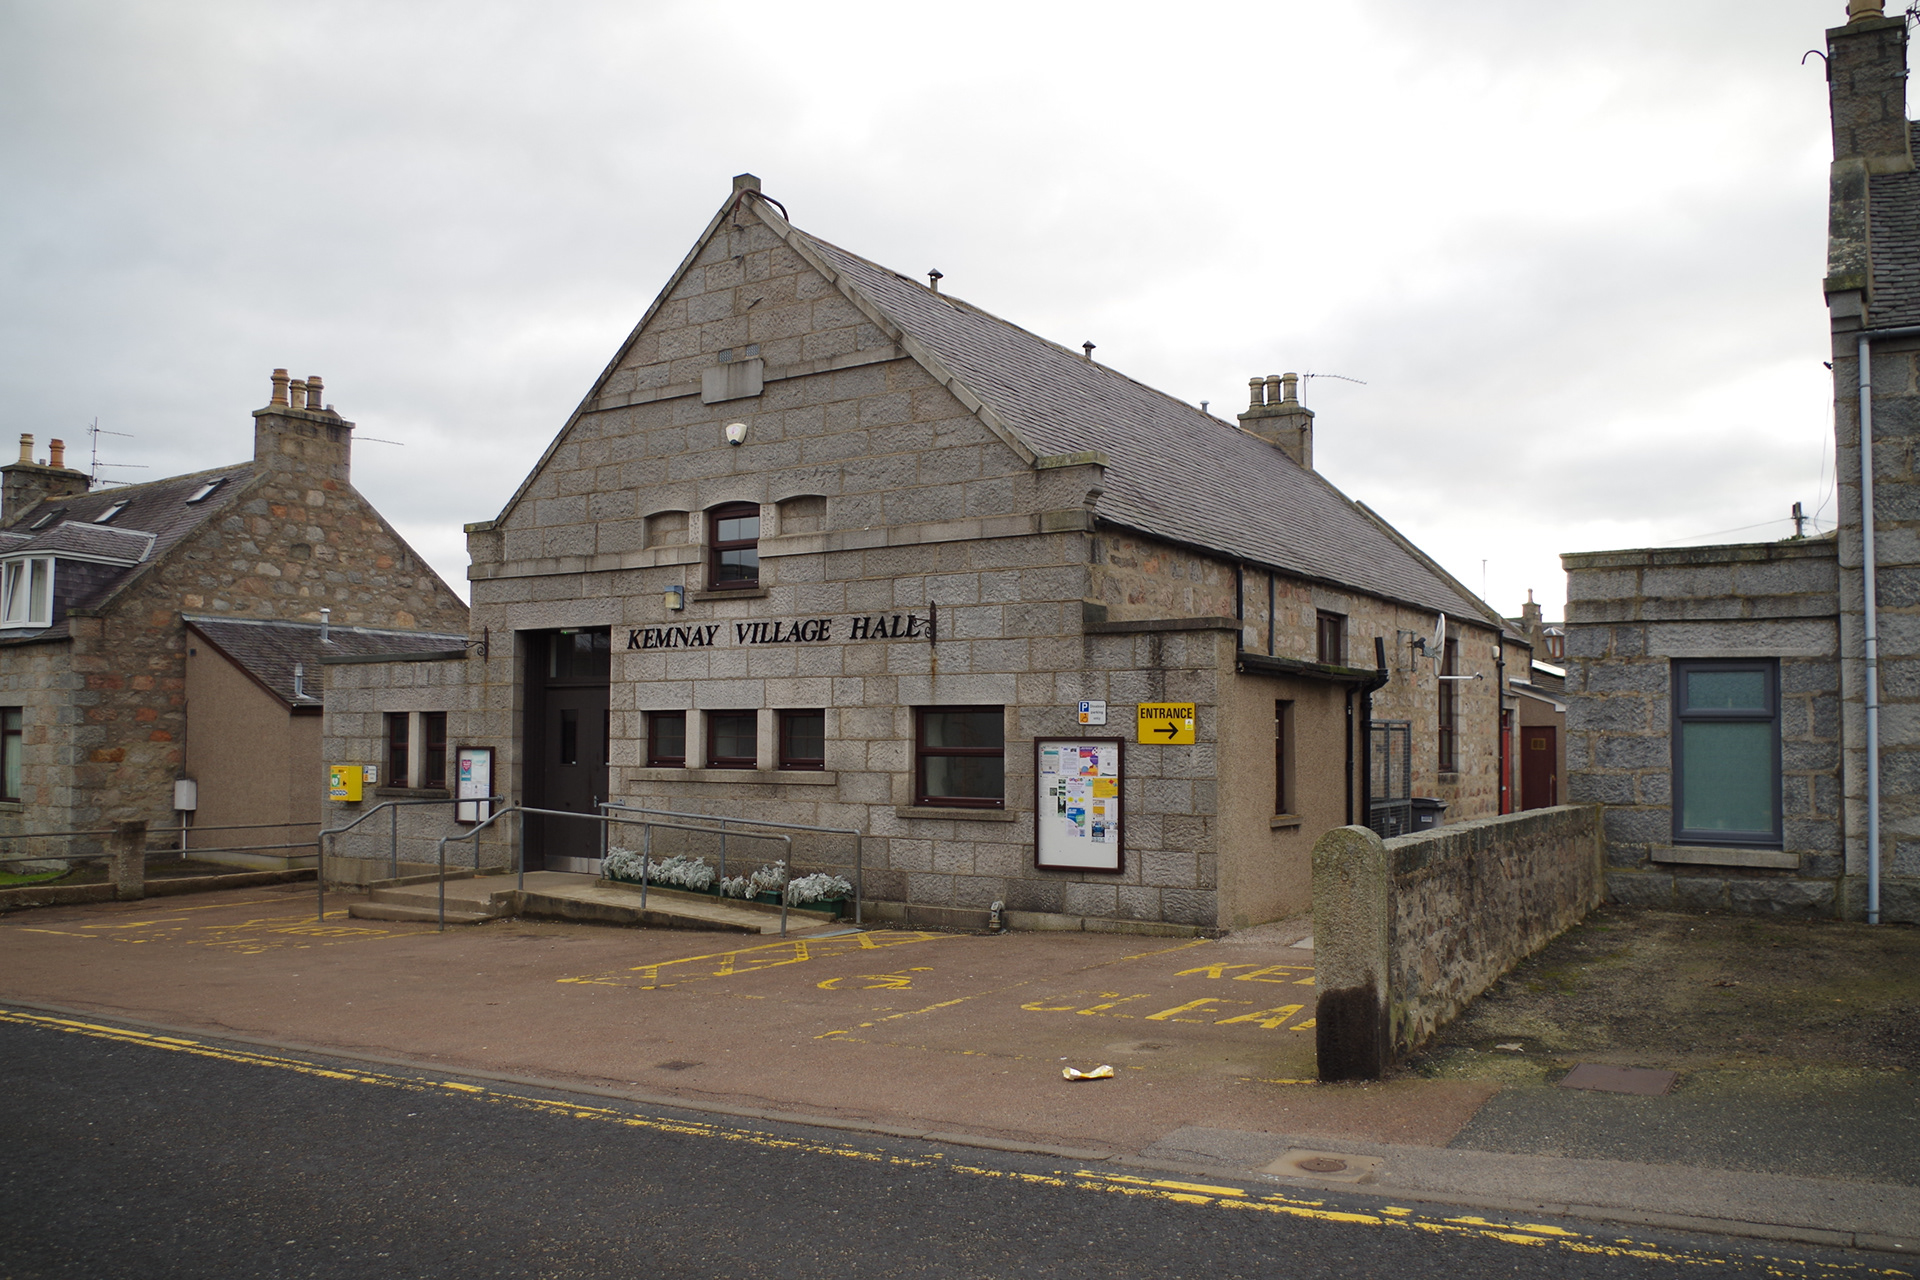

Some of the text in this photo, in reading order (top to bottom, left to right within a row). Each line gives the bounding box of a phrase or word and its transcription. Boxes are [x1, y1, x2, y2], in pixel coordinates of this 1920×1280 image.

[627, 614, 920, 650] KEMNAY VILLAGE HALL
[1140, 707, 1193, 719] ENTRANCE
[1174, 962, 1316, 985] KE
